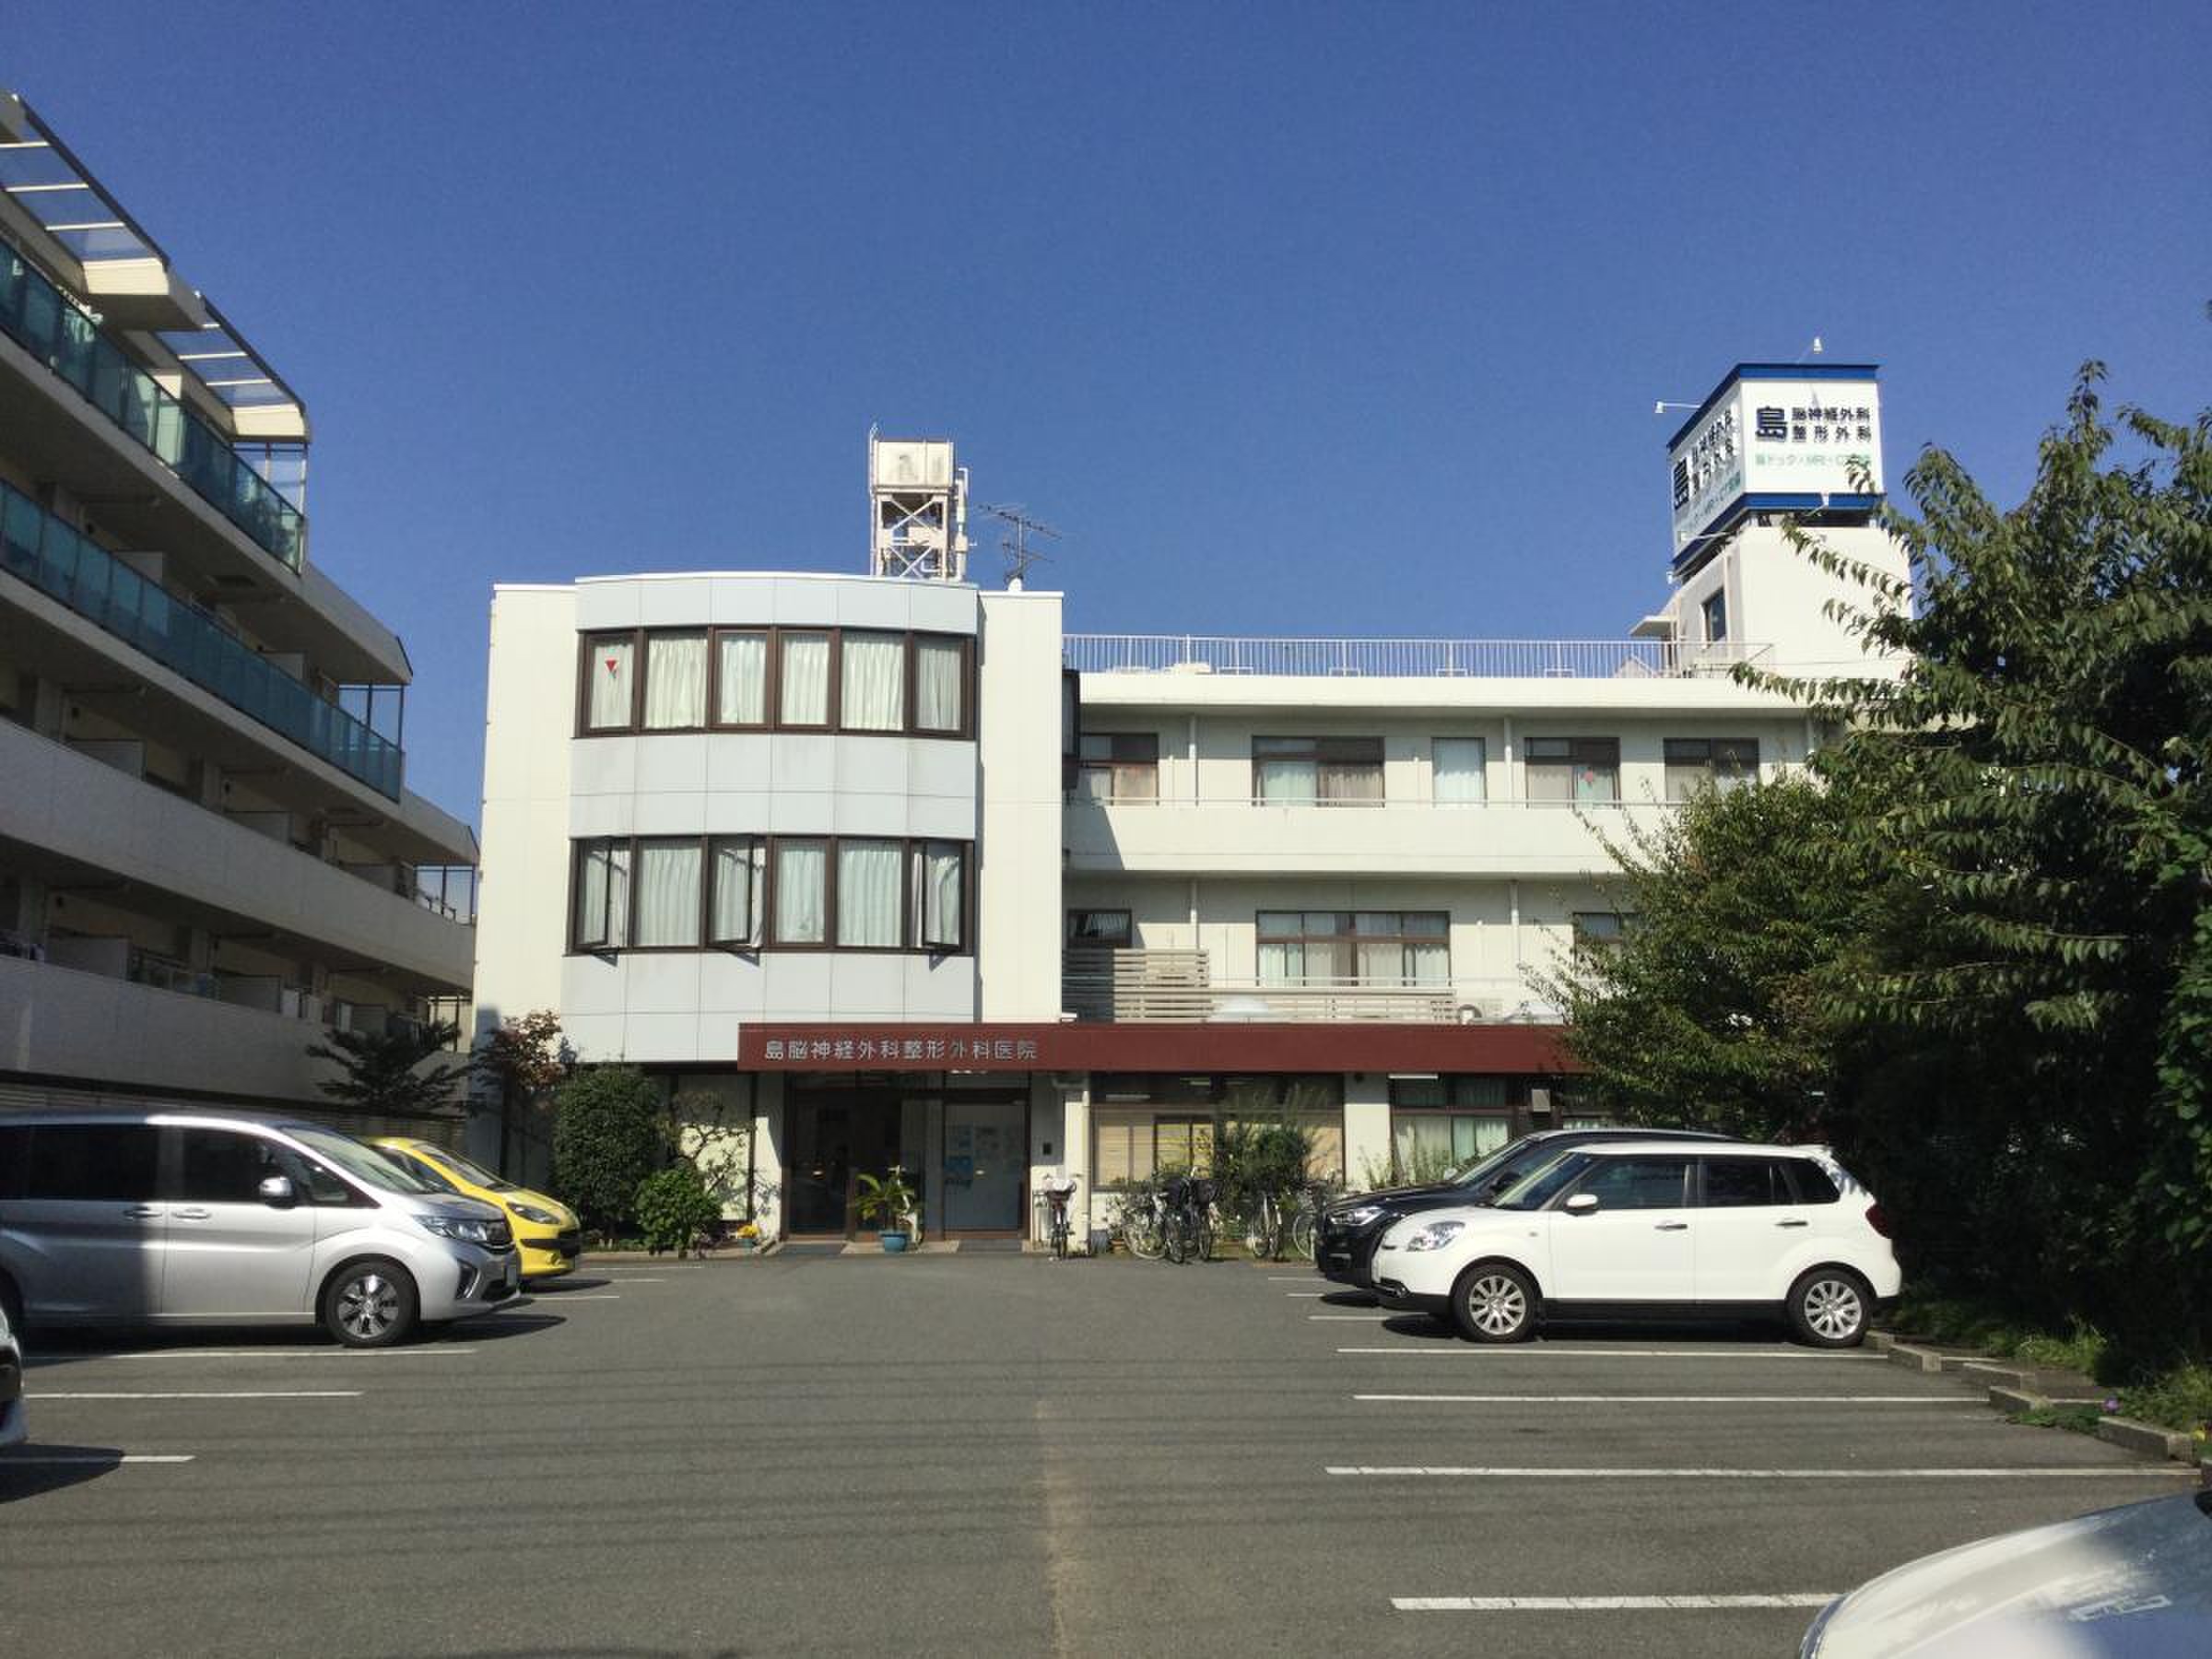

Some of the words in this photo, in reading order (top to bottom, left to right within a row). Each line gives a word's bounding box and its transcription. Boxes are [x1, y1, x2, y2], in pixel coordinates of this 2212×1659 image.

[1792, 406, 1870, 421] 脳神経外科
[1755, 406, 1787, 440] 島
[1792, 425, 1872, 441] 整形外科
[765, 1040, 1038, 1060] 島脳神経外科整形外科医院
